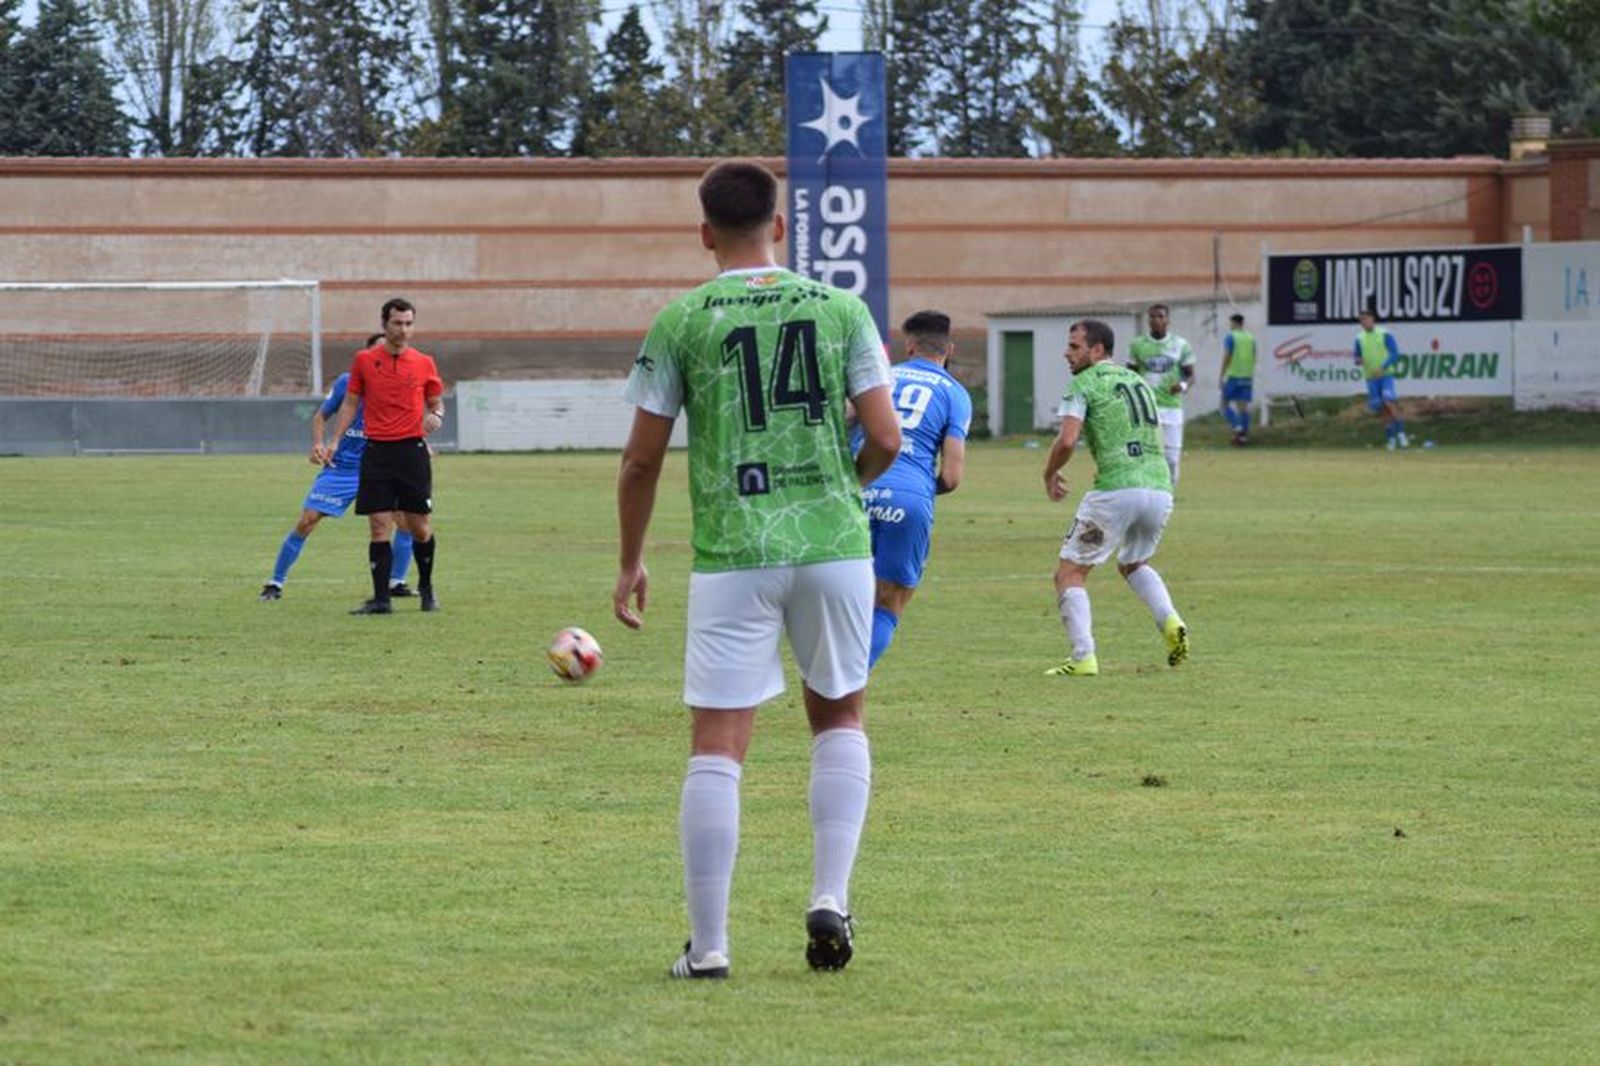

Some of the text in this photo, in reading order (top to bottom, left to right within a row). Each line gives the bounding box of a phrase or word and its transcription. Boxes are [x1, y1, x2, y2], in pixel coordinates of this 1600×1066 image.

[795, 188, 809, 211] LA
[1325, 255, 1465, 319] IMPULSO27
[720, 319, 827, 432] 14
[1391, 353, 1499, 379] OVIRAN
[889, 380, 933, 429] 9
[1115, 382, 1159, 428] 10
